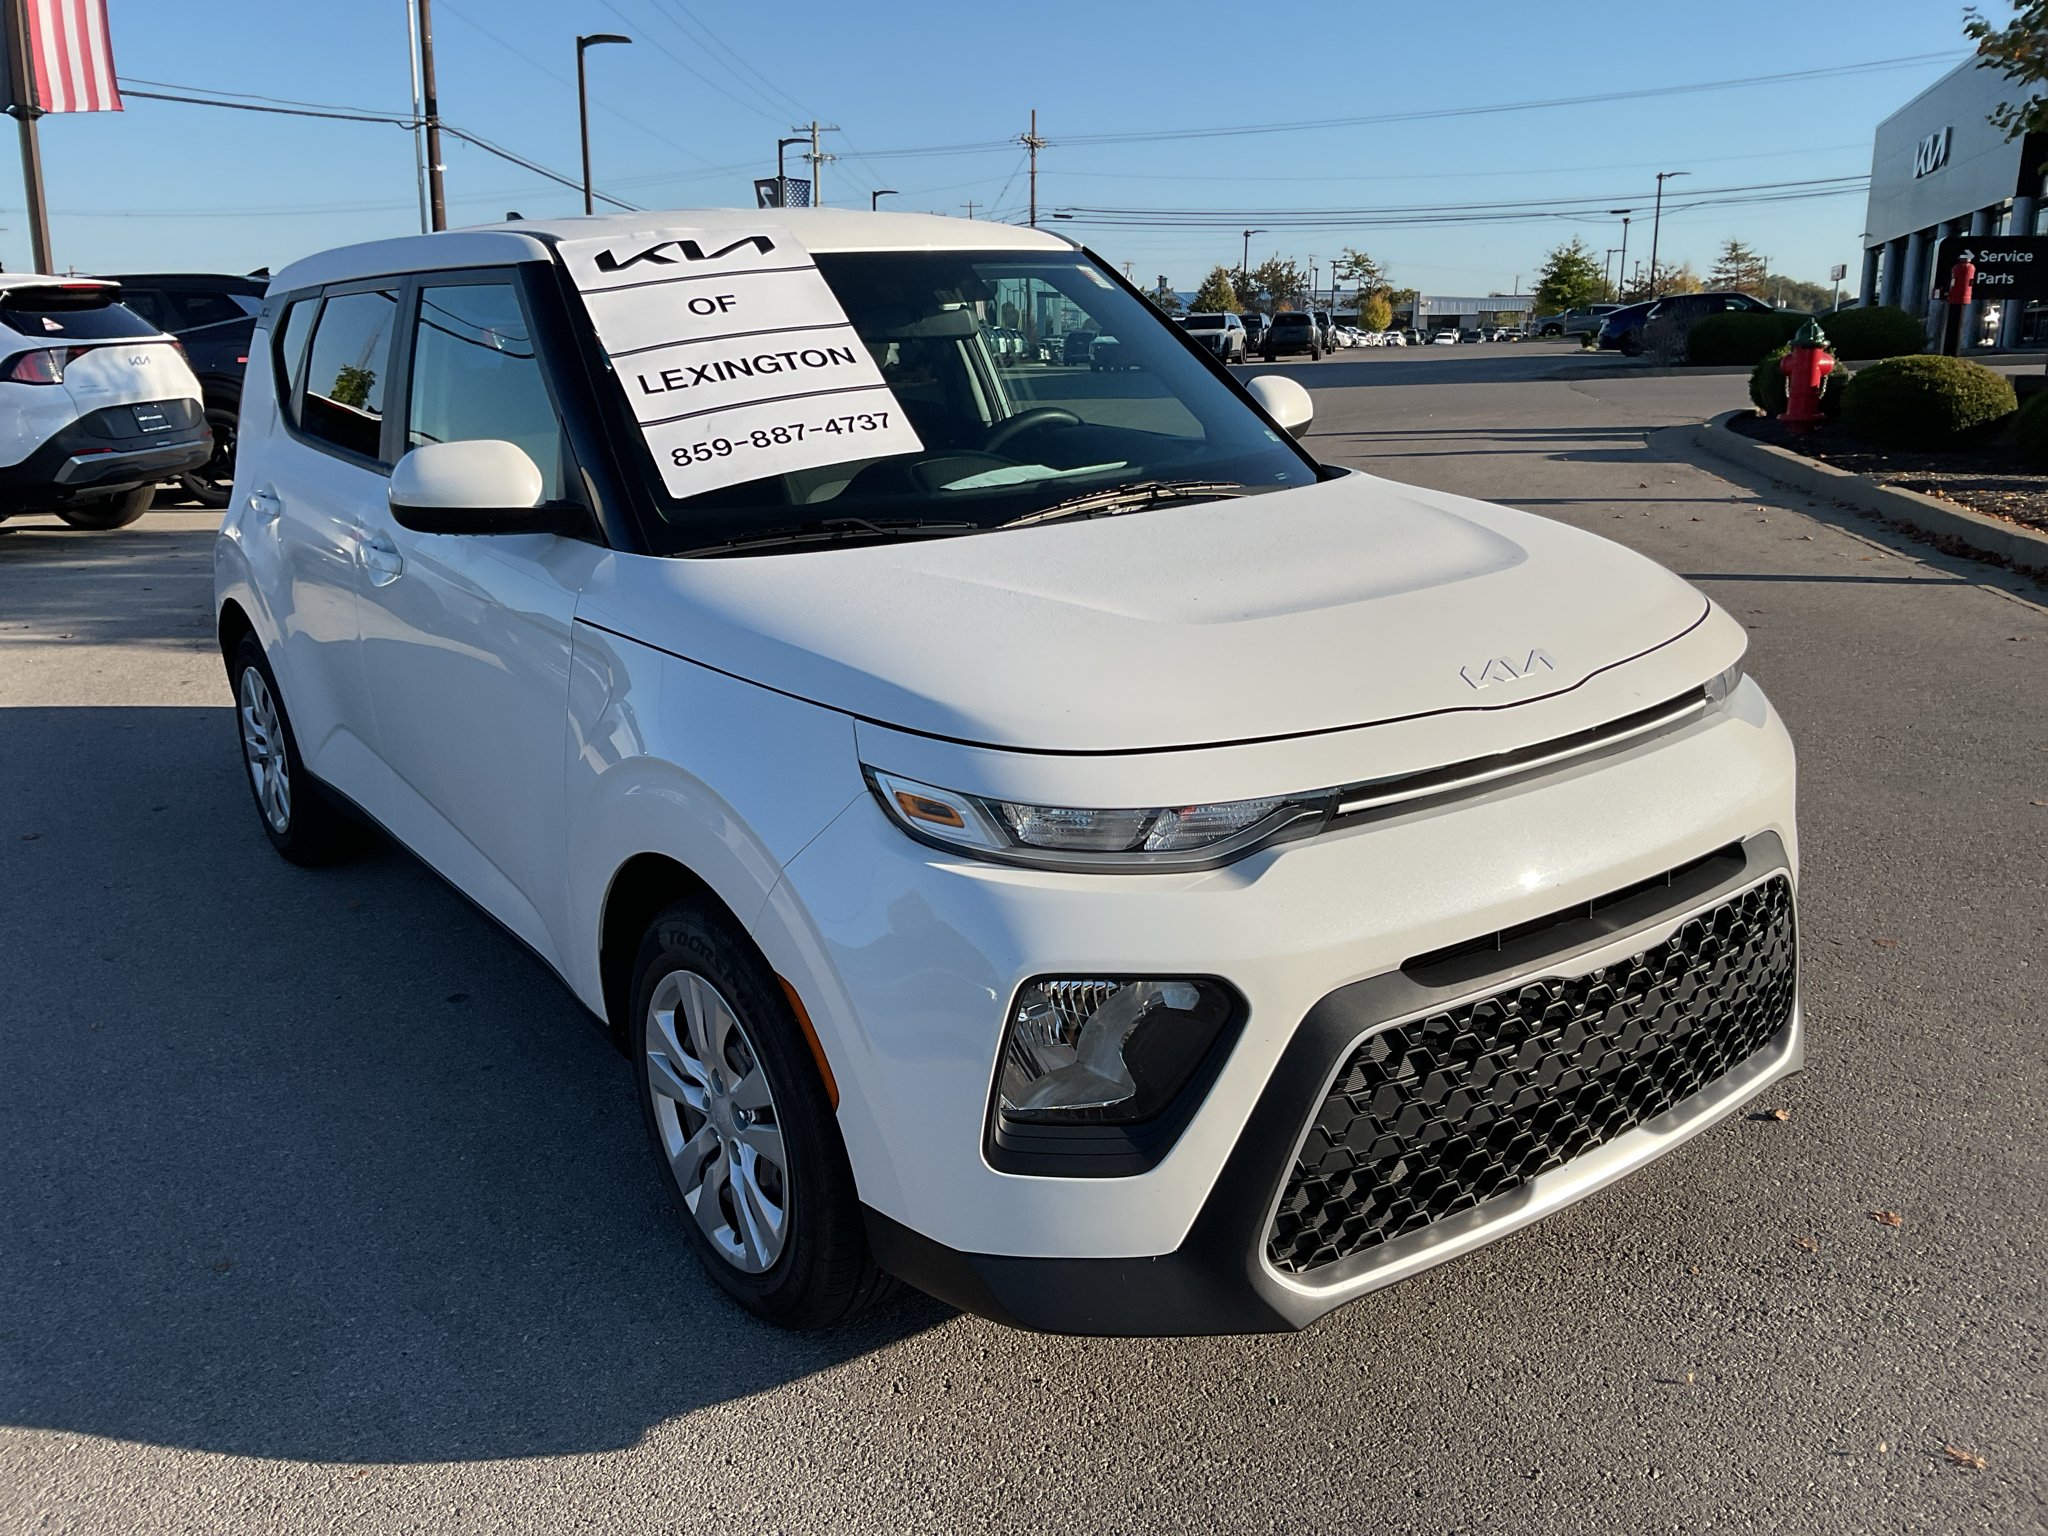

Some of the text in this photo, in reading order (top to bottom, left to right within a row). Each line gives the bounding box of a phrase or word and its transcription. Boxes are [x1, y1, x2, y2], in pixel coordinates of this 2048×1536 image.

[1913, 126, 1950, 179] KIA
[594, 235, 776, 273] KIA
[1979, 250, 2034, 263] Service
[1976, 272, 2015, 285] Parts
[687, 294, 737, 316] OF
[128, 356, 151, 367] KIA
[637, 346, 857, 395] LEXINGTON
[670, 412, 890, 467] 859-887-4737
[1460, 648, 1556, 690] KIA
